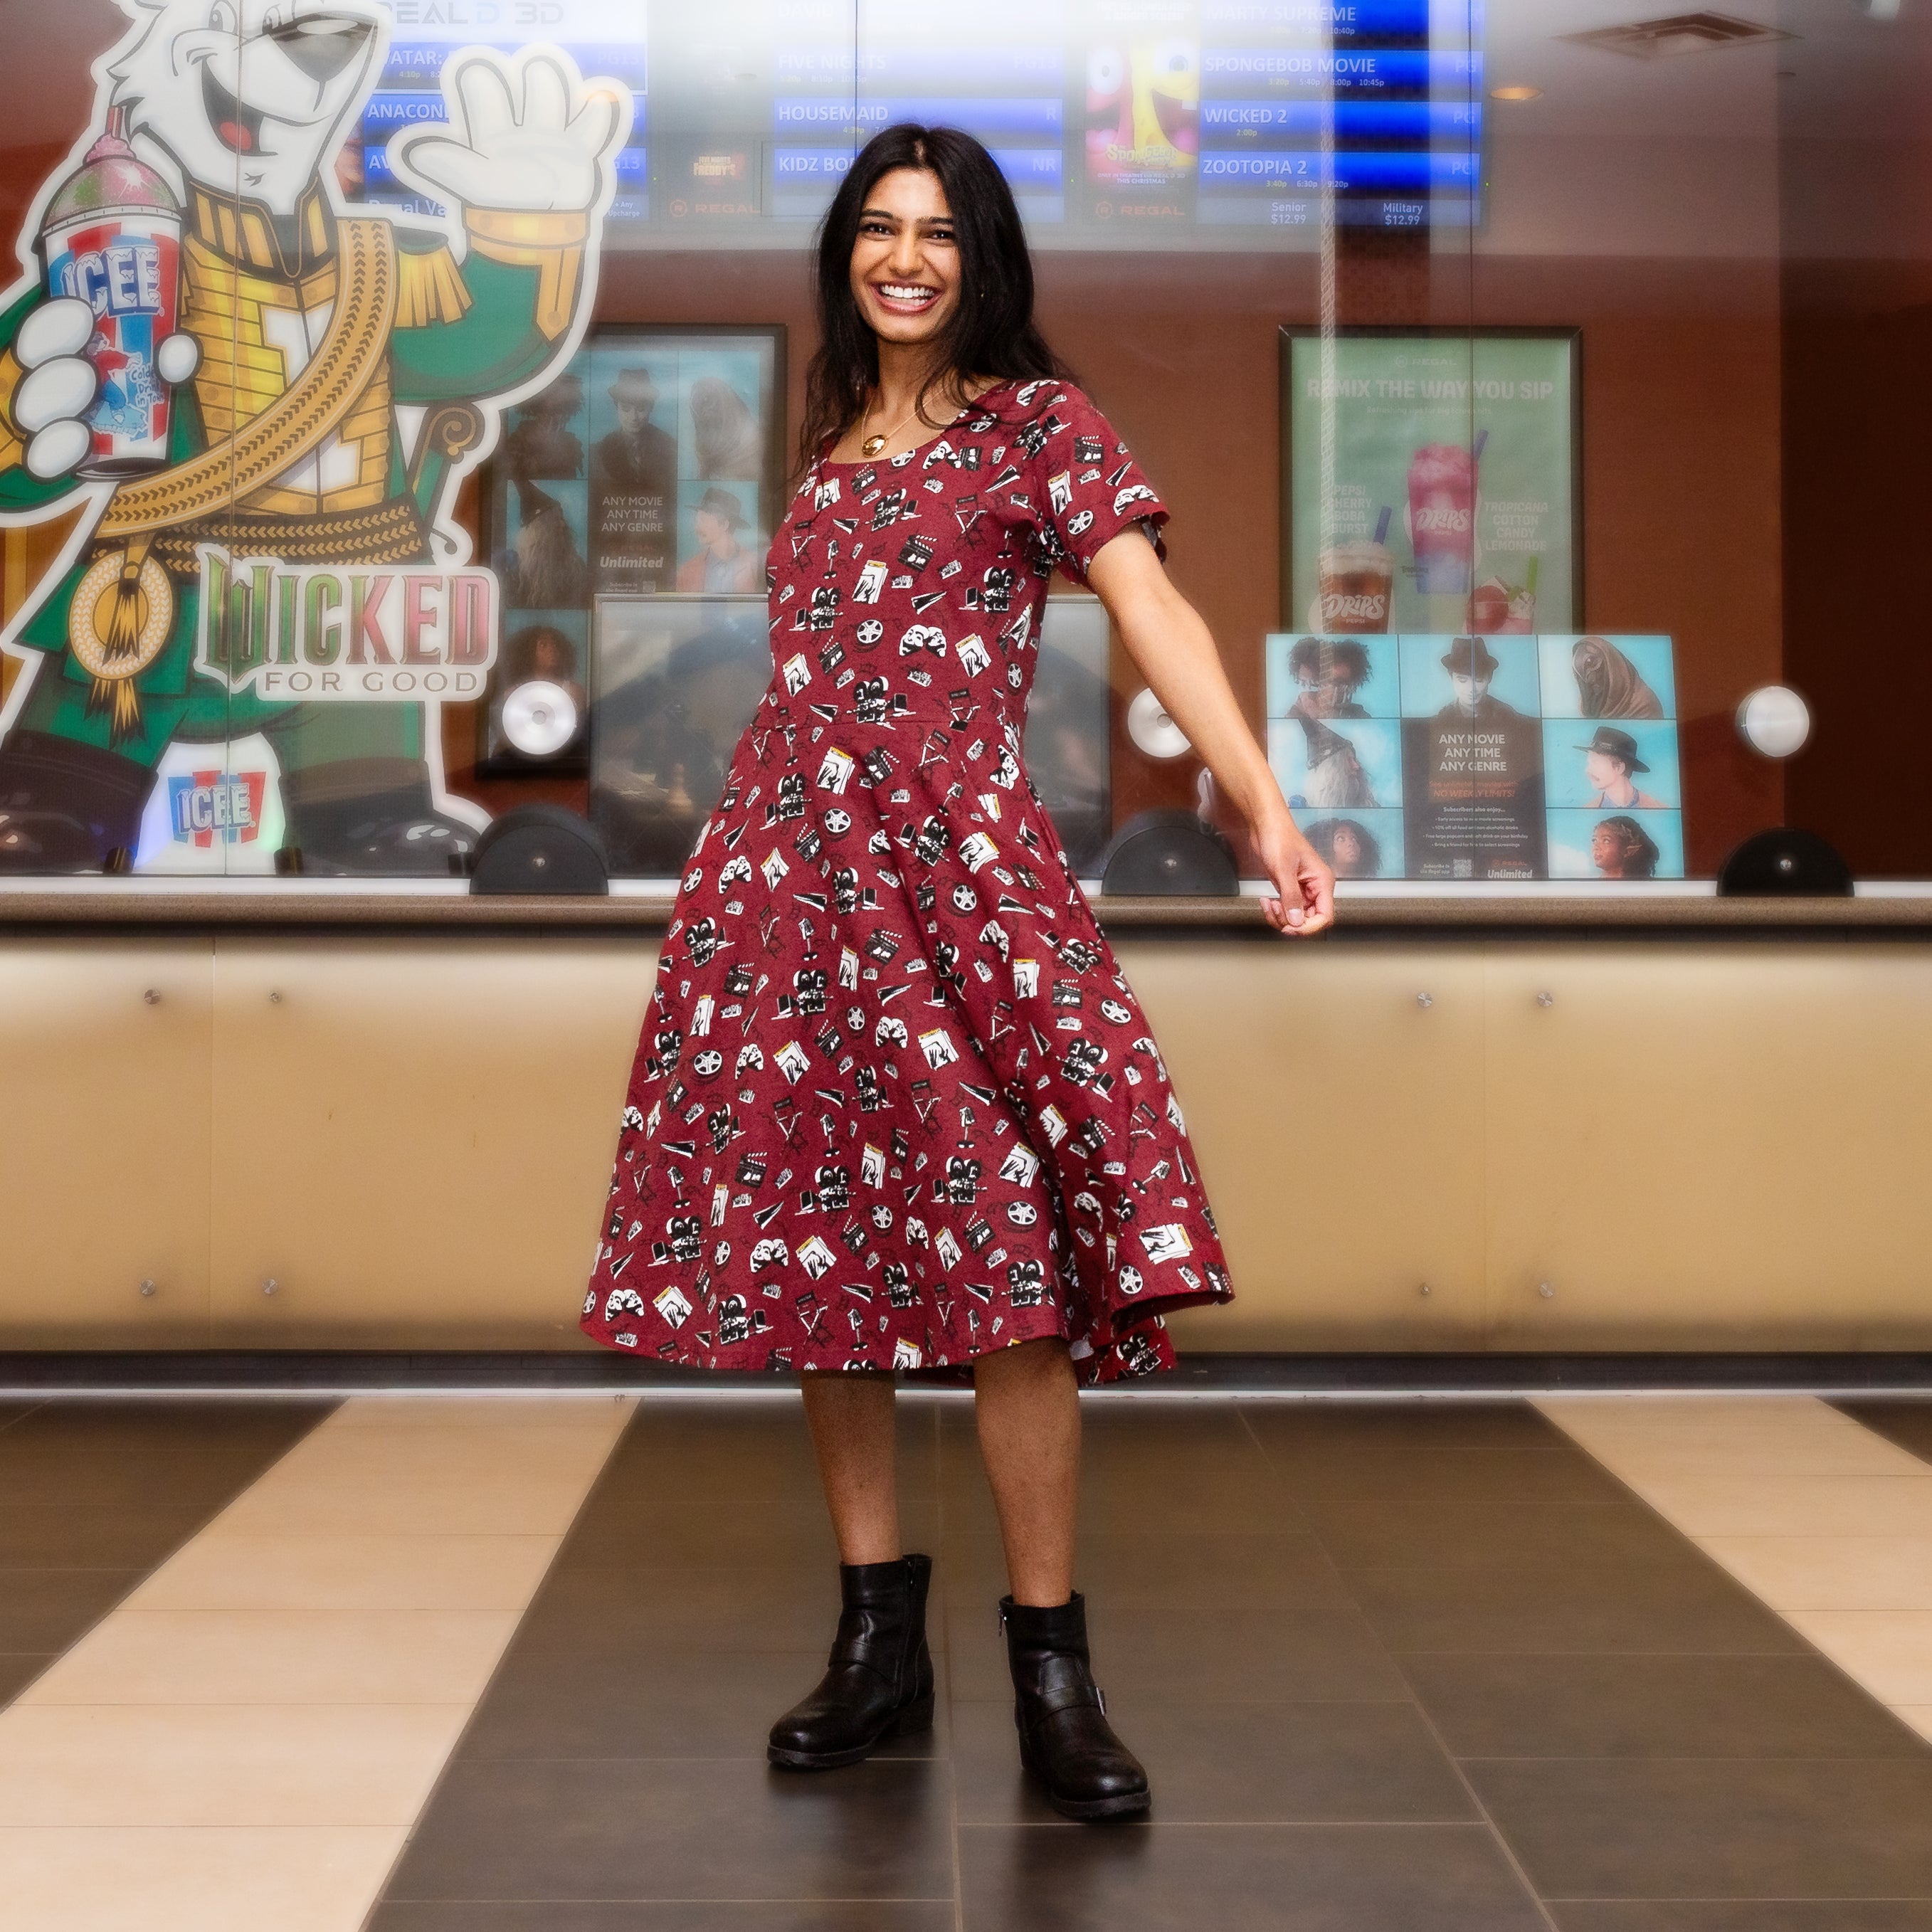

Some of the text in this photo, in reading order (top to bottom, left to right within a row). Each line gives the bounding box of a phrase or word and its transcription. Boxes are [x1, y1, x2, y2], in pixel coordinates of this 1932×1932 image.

[390, 2, 468, 24] EAL
[515, 2, 564, 24] 3D
[1206, 6, 1269, 21] MARTY
[1274, 6, 1356, 21] SUPREME
[1329, 27, 1355, 36] 10:40p
[778, 56, 887, 69] FIVE NIGHTS
[1013, 55, 1057, 69] PG13
[1205, 58, 1376, 73] SPONGEBOB MOVIE
[1455, 59, 1477, 73] PG
[1269, 78, 1289, 87] 3:20p
[1299, 78, 1321, 87] 5:40p
[1359, 79, 1384, 88] 10:45p
[367, 104, 450, 119] ANACON
[778, 106, 888, 121] HOUSEMAID
[1047, 107, 1057, 120] R
[1205, 109, 1287, 124] WICKED 2
[1453, 112, 1474, 125] PG
[1237, 129, 1257, 137] 2:00p
[779, 157, 818, 171] KIDZ
[1033, 159, 1057, 171] NR
[1203, 159, 1307, 175] ZOOTOPIA 2
[1266, 180, 1348, 189] 3:40p 6:30p 9:20p
[620, 200, 633, 210] Any
[695, 204, 761, 213] REGAL
[1121, 206, 1186, 216] REGAL
[1272, 202, 1307, 212] Senior
[1383, 202, 1422, 215] Military
[608, 208, 640, 220] Upcharge
[1271, 213, 1307, 226] $12.99
[1385, 214, 1420, 226] $12.99
[60, 245, 160, 319] ICEE
[1307, 379, 1553, 399] RMIX THE WAY YOU SIP
[137, 395, 145, 405] in
[1334, 485, 1366, 495] PEPSI
[602, 497, 663, 506] ANY MOVIE
[1484, 502, 1548, 512] TROPICANA
[606, 510, 658, 519] ANY TIME
[1333, 510, 1366, 521] BOBA
[1492, 514, 1538, 525] COTTON
[601, 522, 663, 532] ANY GENRE
[1331, 523, 1368, 534] BURST
[1496, 527, 1536, 539] CANDY
[1485, 539, 1547, 551] LEMONADE
[600, 556, 664, 569] Unlimited
[202, 551, 491, 684] WICKED
[265, 672, 477, 692] FOR GOOD
[1439, 734, 1506, 744] ANY MOVIE
[1444, 748, 1501, 758] ANY TIME
[1439, 761, 1507, 771] ANY GENRE
[177, 783, 253, 834] ICEE
[1487, 869, 1533, 879] Unlimited
